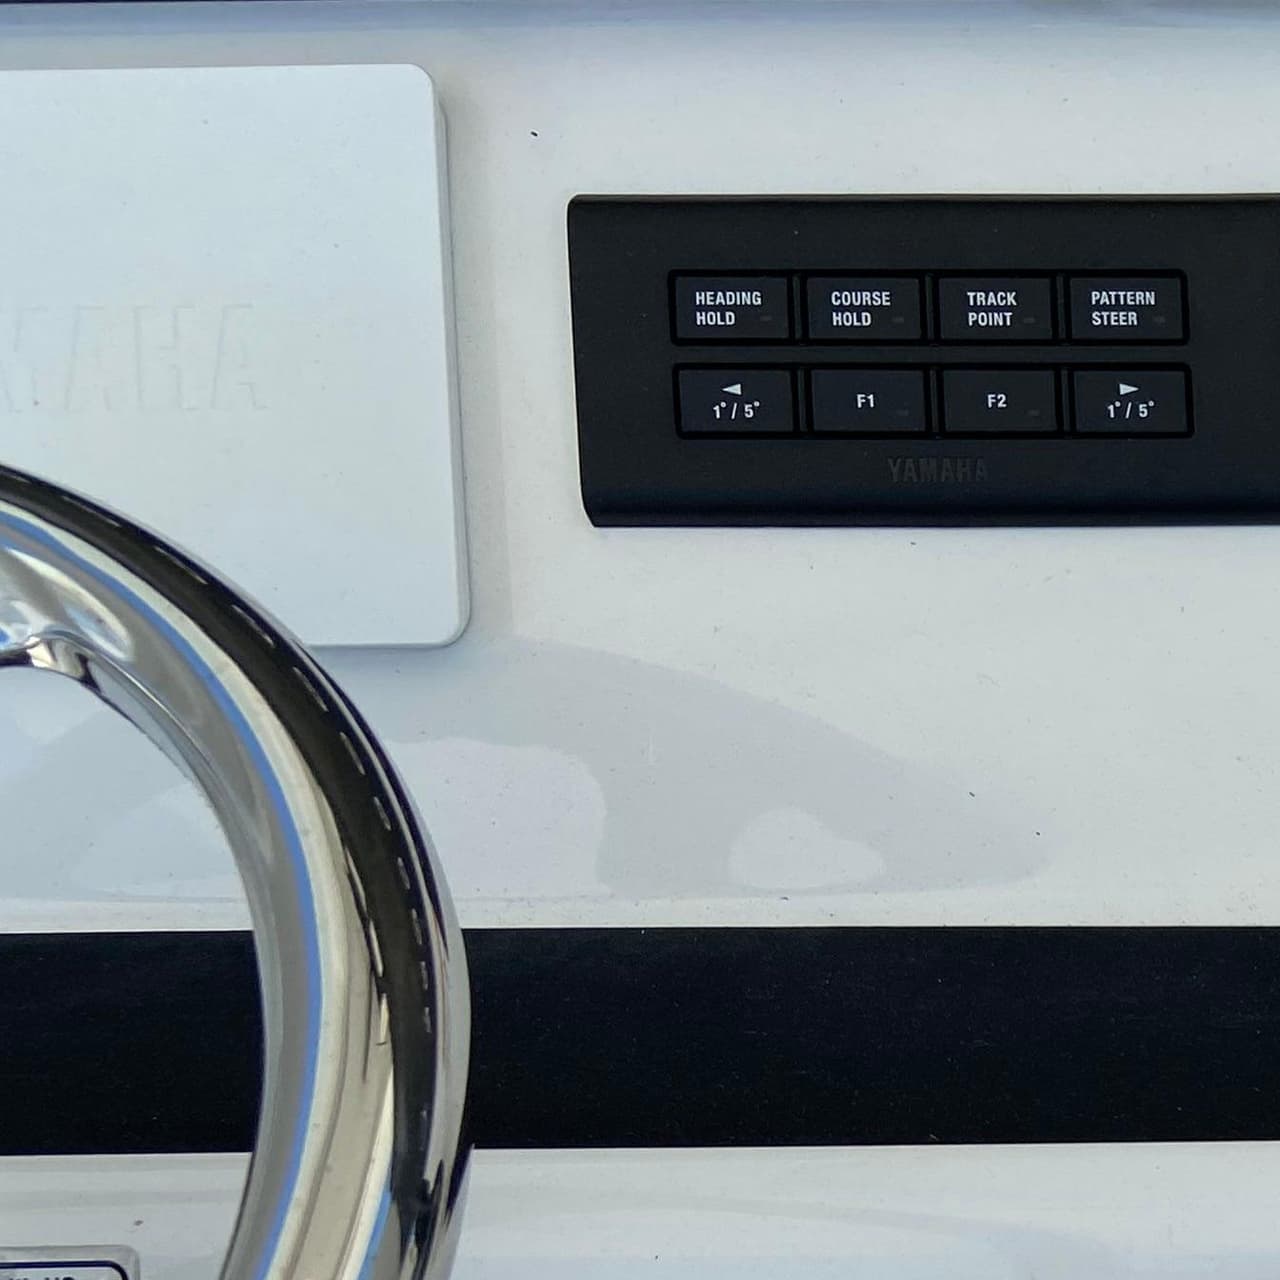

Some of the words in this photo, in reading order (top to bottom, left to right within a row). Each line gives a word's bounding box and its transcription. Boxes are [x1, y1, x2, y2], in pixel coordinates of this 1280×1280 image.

[696, 291, 762, 305] HEADING
[831, 291, 891, 306] COURSE
[967, 291, 1017, 306] TRACK
[1091, 291, 1155, 305] PATTERN
[696, 312, 735, 325] HOLD
[832, 312, 872, 326] HOLD
[968, 312, 1013, 326] POINT
[1092, 311, 1138, 325] STEER
[857, 394, 875, 408] F1
[988, 394, 1007, 408] F2
[887, 457, 989, 483] YAMAHA
